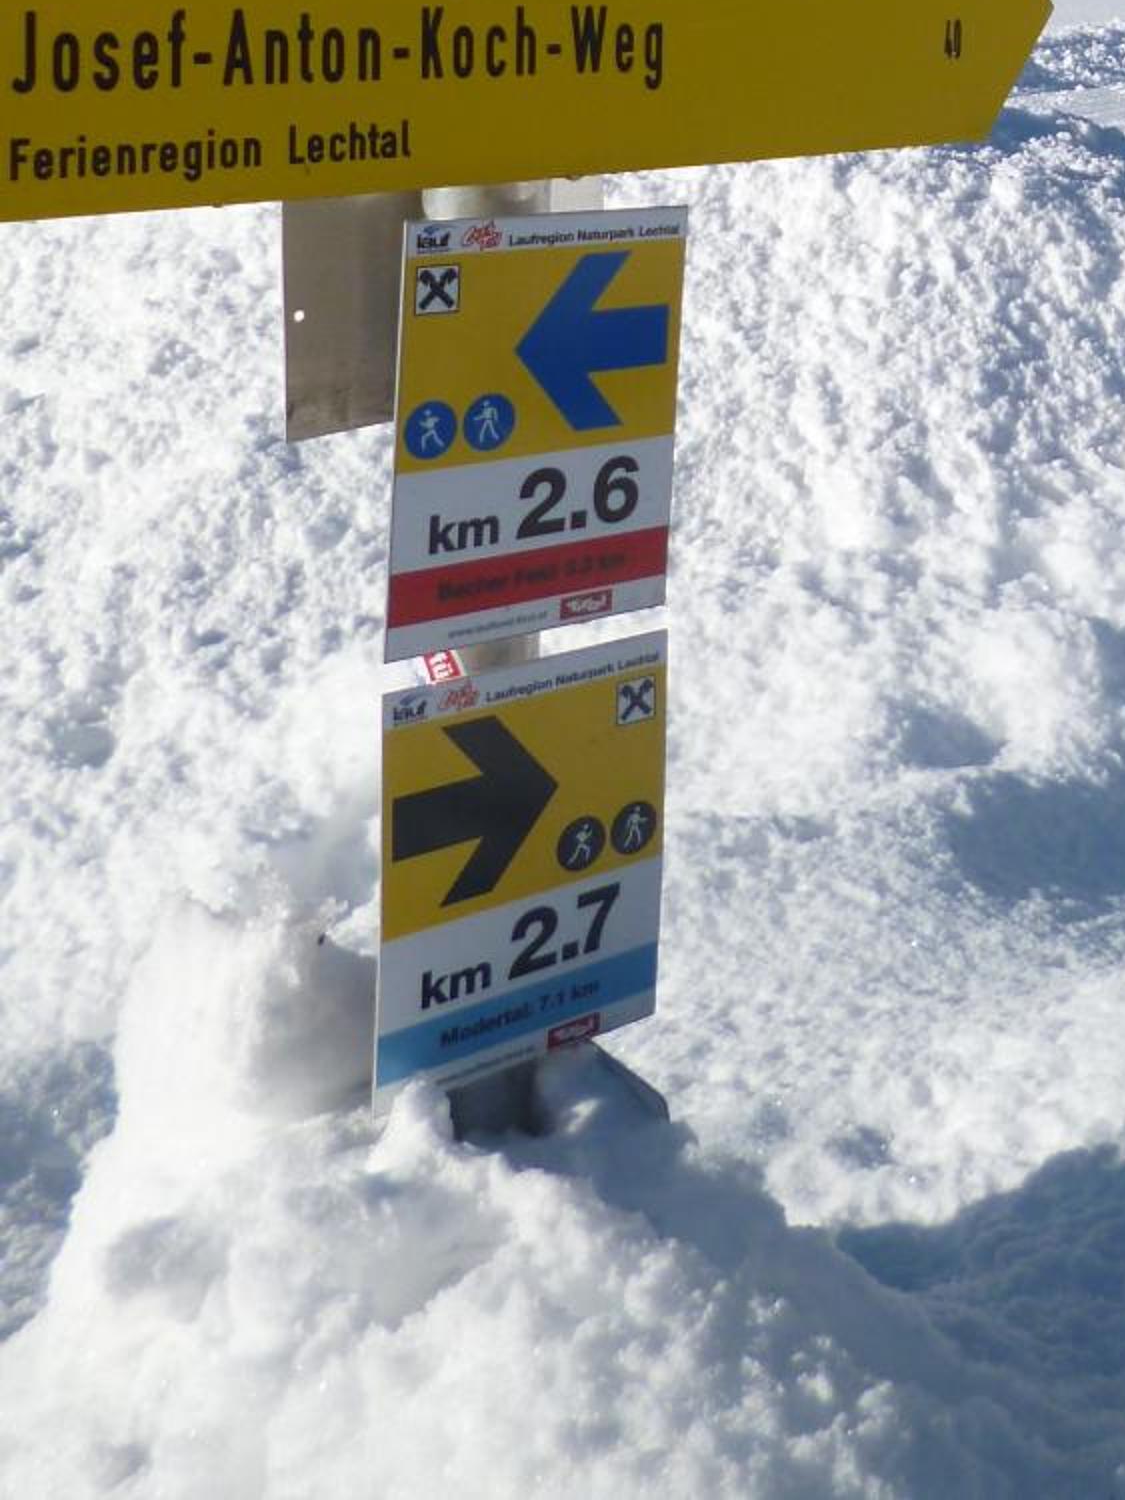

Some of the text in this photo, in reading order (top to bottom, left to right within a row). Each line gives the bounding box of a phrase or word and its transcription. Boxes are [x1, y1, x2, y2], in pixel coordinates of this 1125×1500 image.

[11, 5, 665, 94] Josef-Anton-Koch-Weg
[944, 19, 962, 59] 40
[9, 120, 411, 181] Ferienregion Lechtal
[509, 229, 574, 248] Laufregion
[428, 455, 640, 555] km 2.6
[420, 882, 622, 1011] km 2.7
